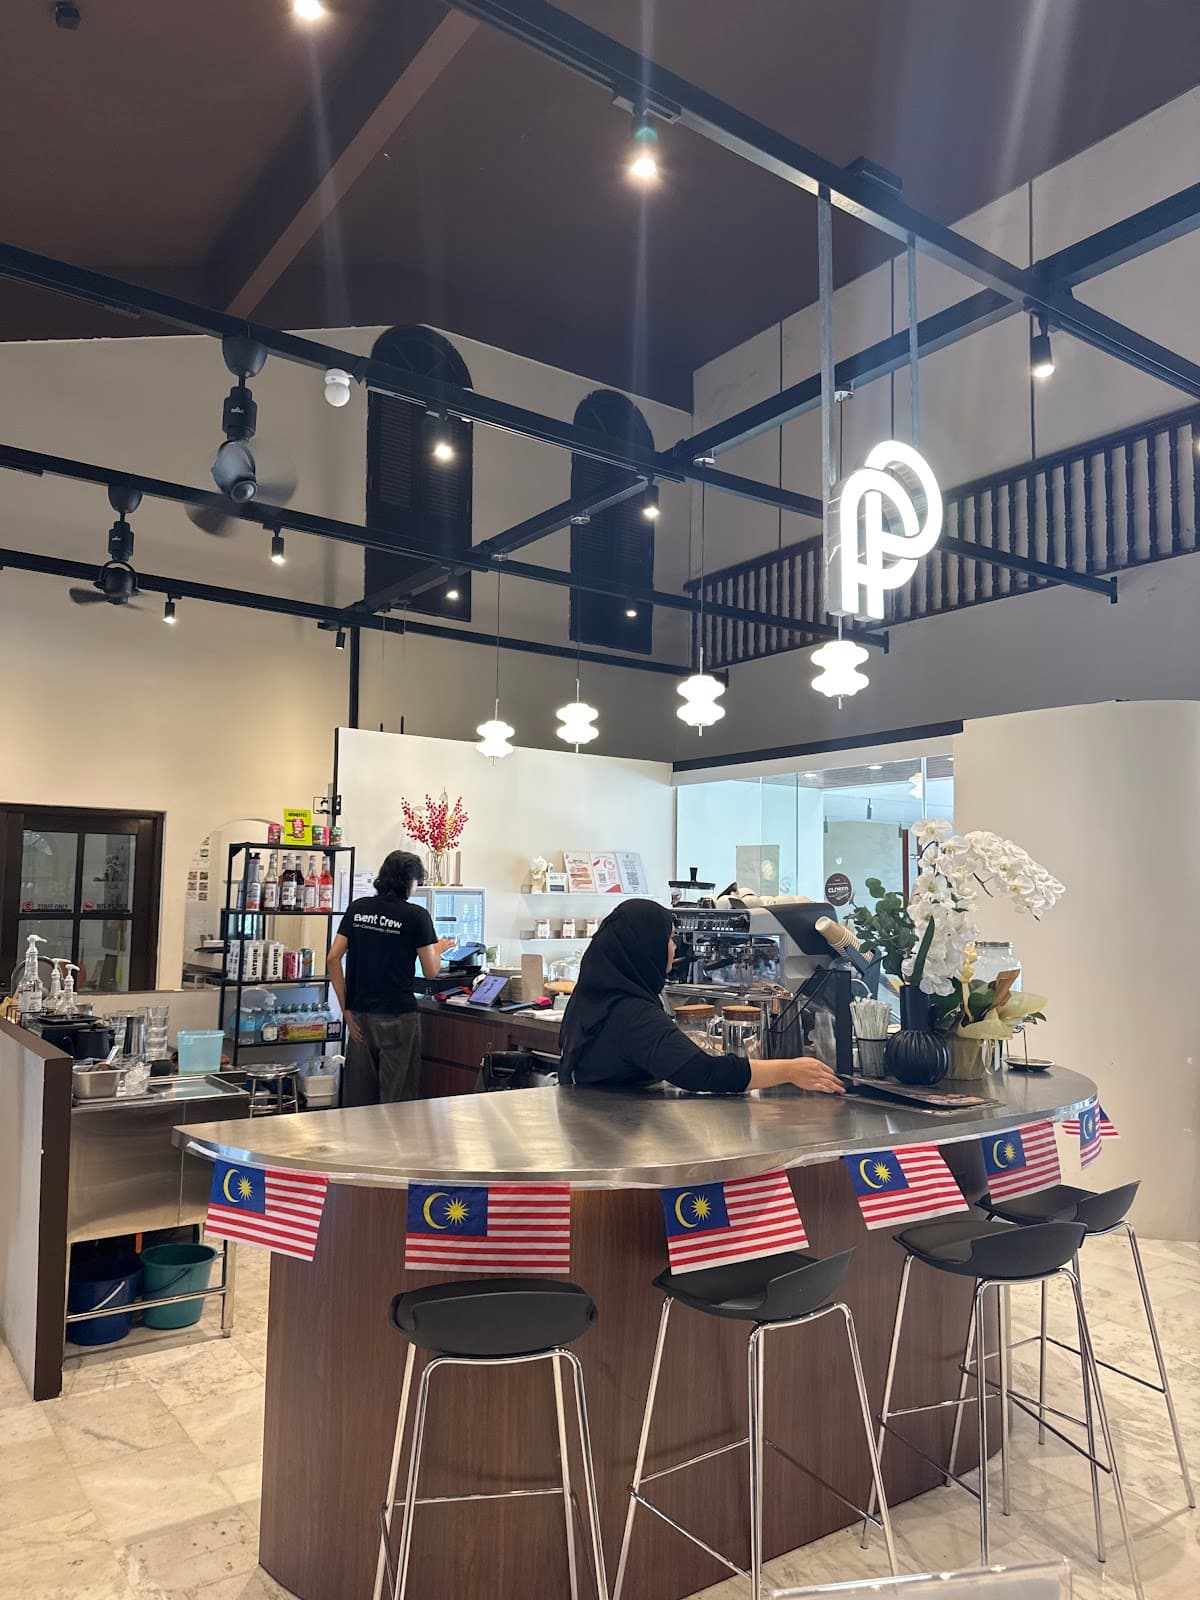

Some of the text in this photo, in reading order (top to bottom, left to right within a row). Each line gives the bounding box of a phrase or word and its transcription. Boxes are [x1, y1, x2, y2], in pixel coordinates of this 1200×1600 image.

[353, 913, 403, 929] Event Crew
[251, 948, 259, 976] OATSIDE
